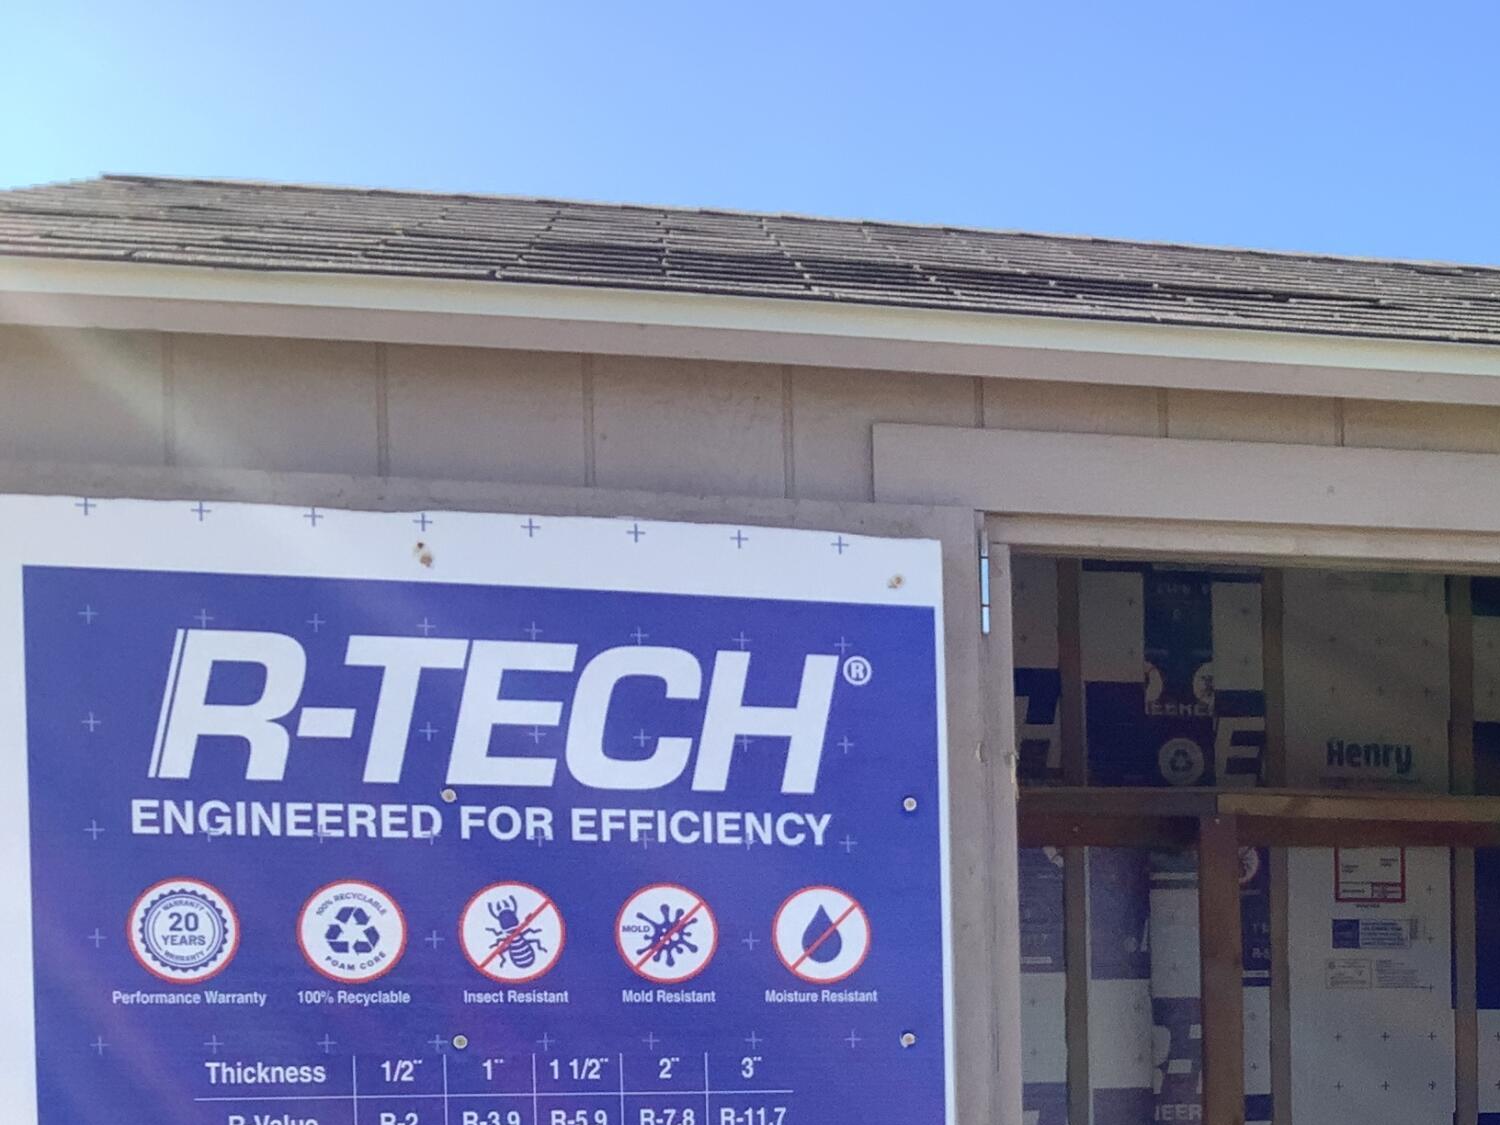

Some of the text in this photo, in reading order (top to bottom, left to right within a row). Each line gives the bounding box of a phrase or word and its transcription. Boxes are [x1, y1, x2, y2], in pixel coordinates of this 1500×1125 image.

[1326, 739, 1413, 775] Henry
[131, 798, 832, 847] ENGINEERED FOR EFFICIENCY
[333, 892, 387, 916] RECYCLABLE
[168, 912, 199, 932] 20
[622, 925, 650, 933] MOLD
[161, 934, 206, 946] YEARS
[325, 951, 386, 970] FOAM CORE
[112, 991, 267, 1006] Performance Warranty
[297, 990, 411, 1006] 100% Recyclable
[463, 989, 569, 1004] Insect Resistant
[622, 989, 716, 1003] Mold Resistant
[765, 989, 878, 1003] Moisture Resistant
[205, 1062, 326, 1084] Thickness
[549, 1059, 559, 1079] 1
